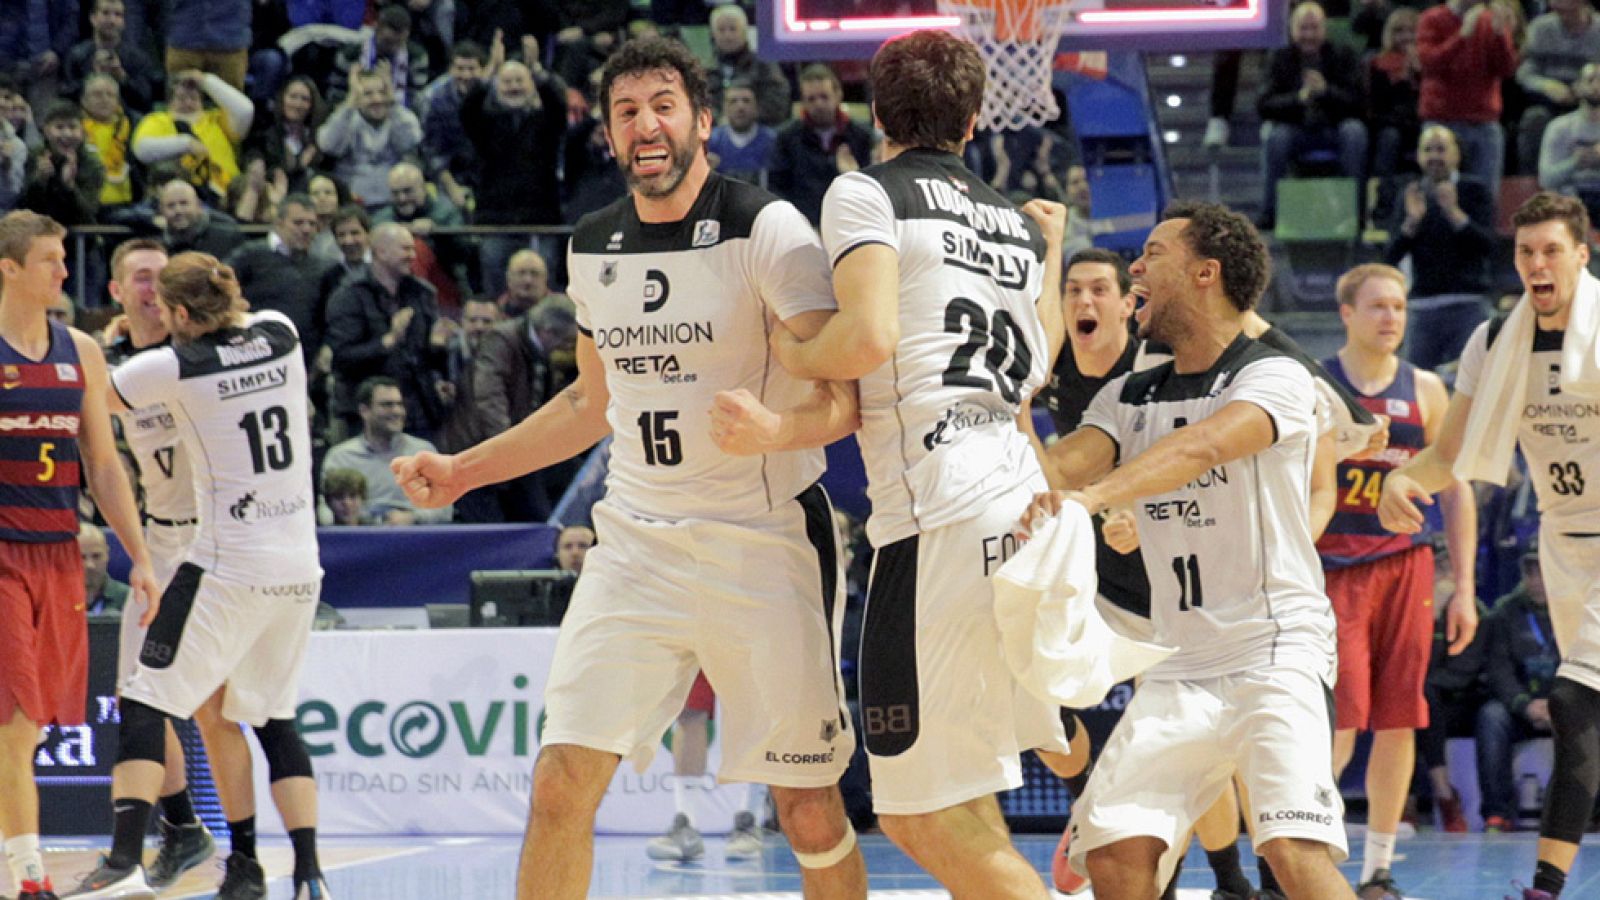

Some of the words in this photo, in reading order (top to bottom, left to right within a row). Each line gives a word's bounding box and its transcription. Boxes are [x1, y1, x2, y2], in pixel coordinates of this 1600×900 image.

[598, 321, 714, 349] DOMINION
[943, 297, 1032, 404] 20
[614, 354, 680, 379] RETA
[1521, 403, 1600, 418] OMINION
[238, 405, 293, 474] 13
[638, 410, 682, 466] 15
[36, 443, 55, 481] 5
[1549, 461, 1584, 496] 33
[1344, 469, 1382, 508] 24
[1144, 500, 1200, 523] RETA
[1172, 554, 1202, 611] 11
[315, 771, 407, 794] TIDAD
